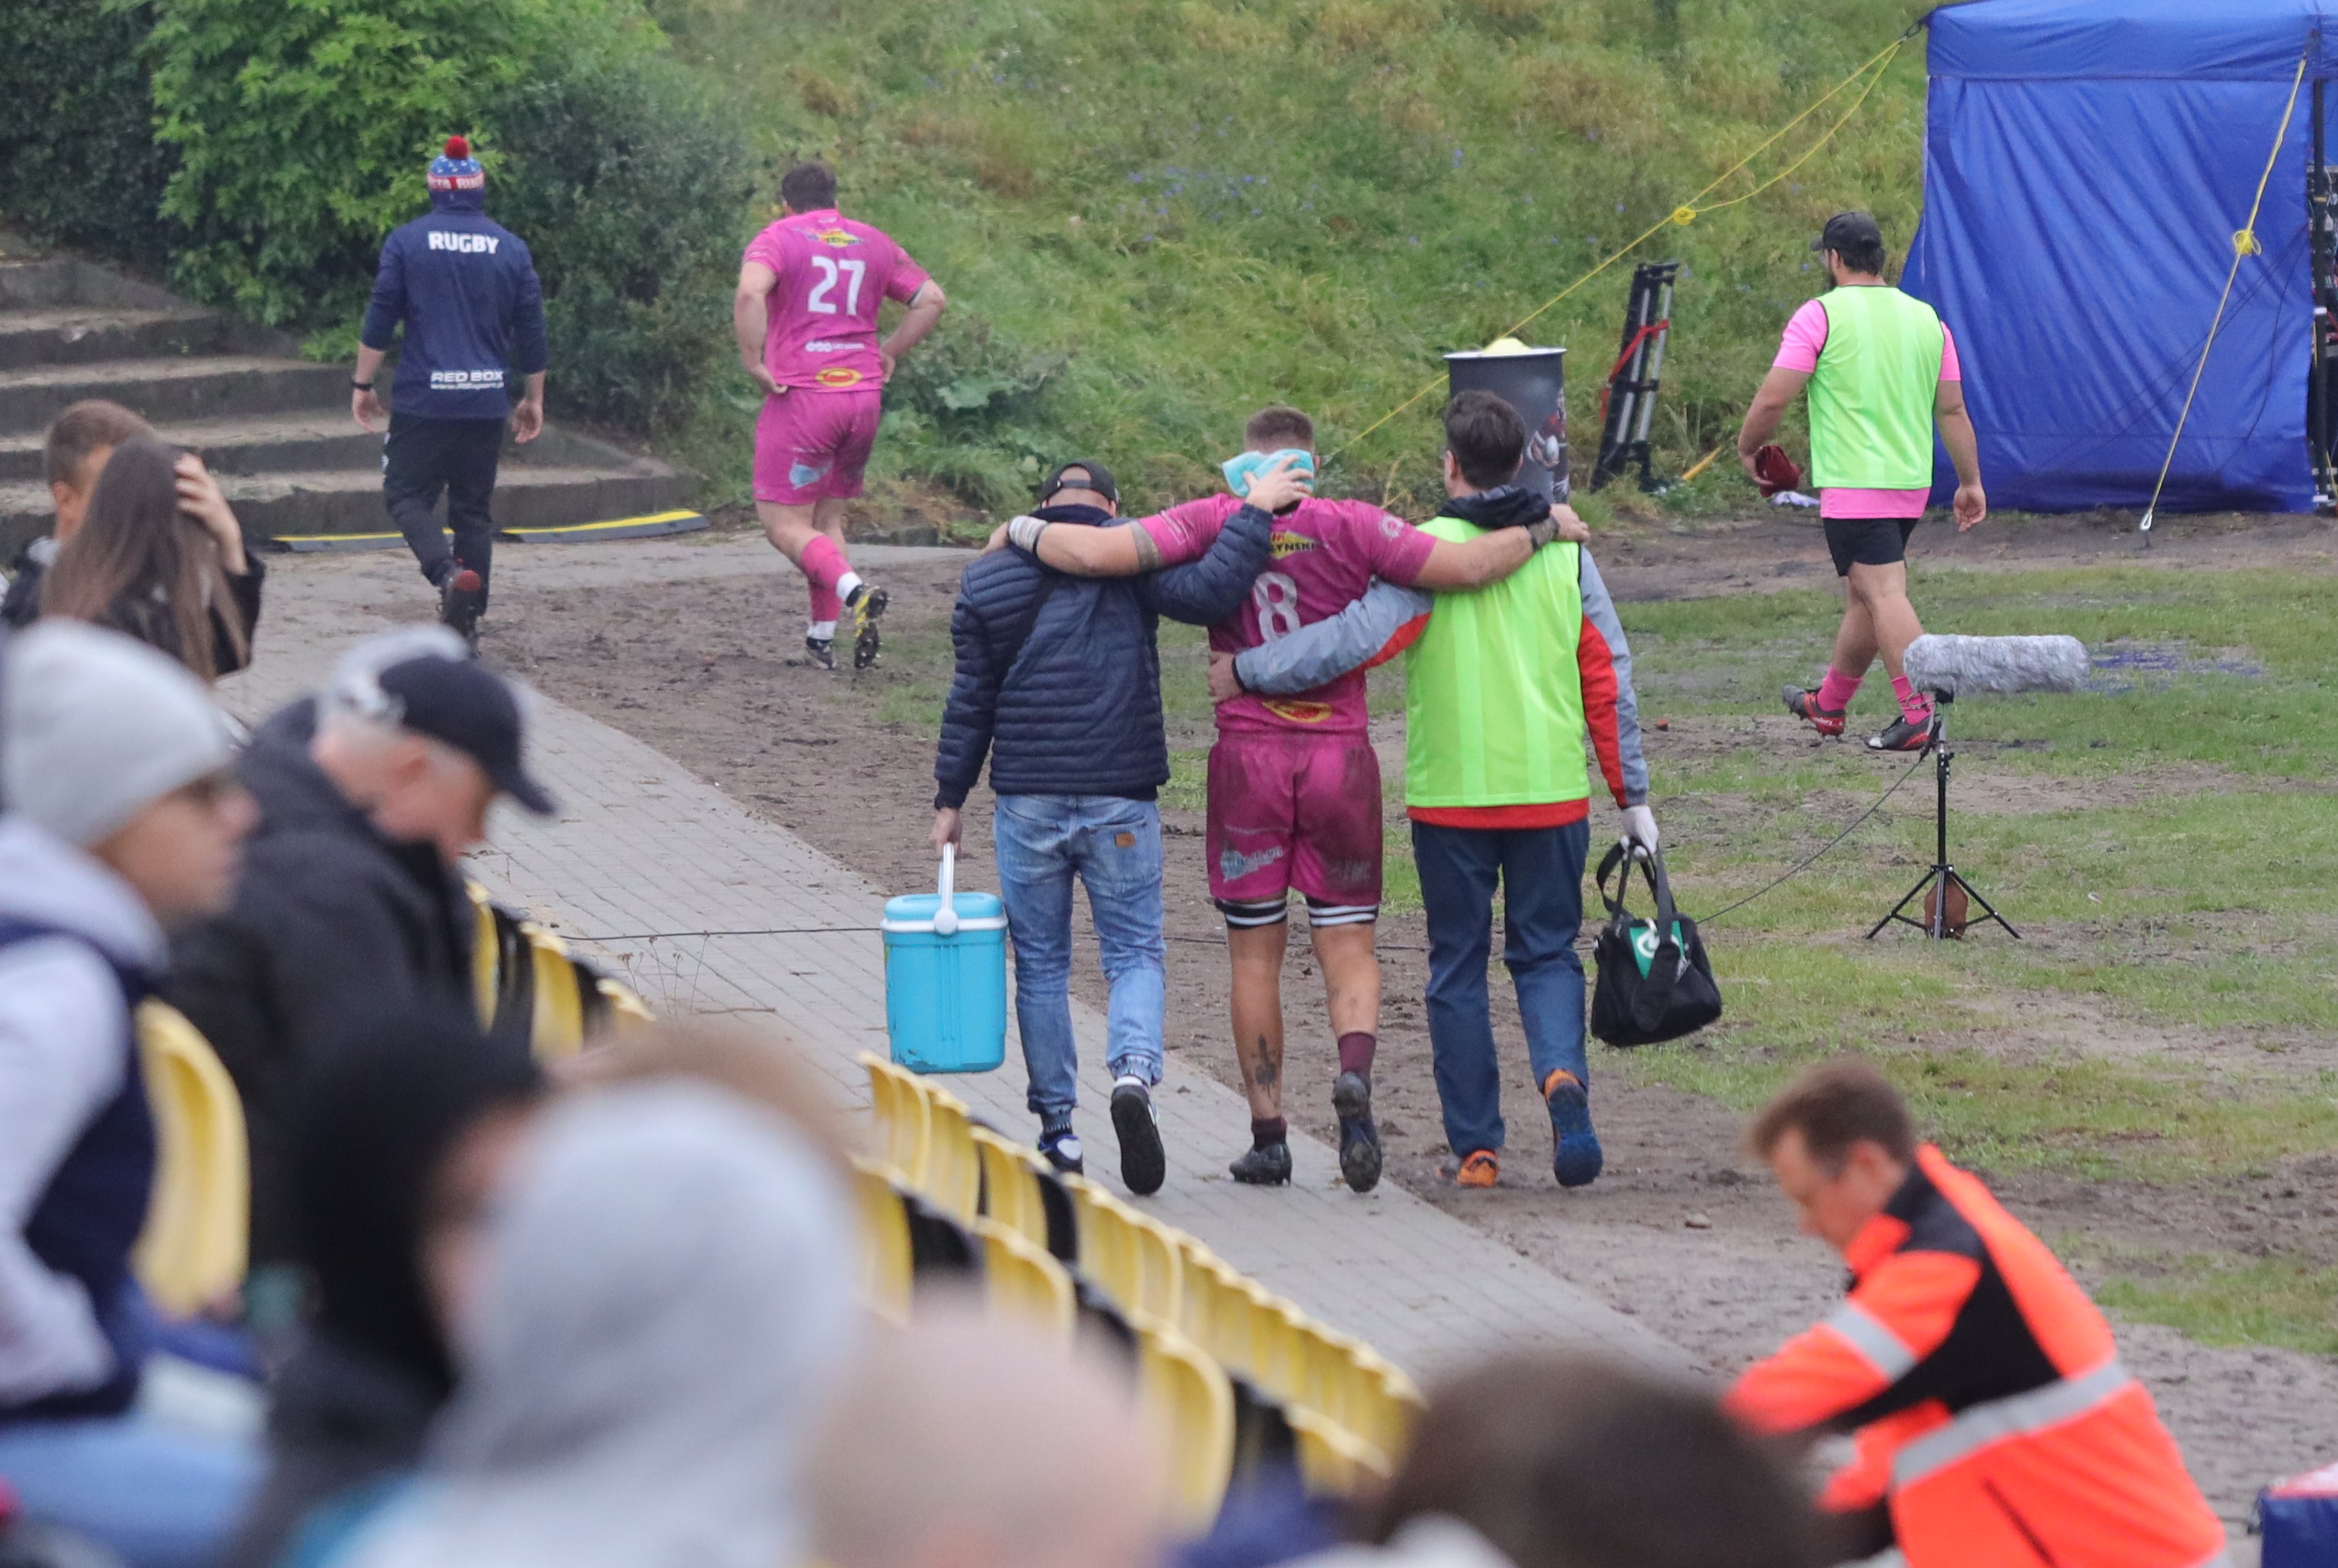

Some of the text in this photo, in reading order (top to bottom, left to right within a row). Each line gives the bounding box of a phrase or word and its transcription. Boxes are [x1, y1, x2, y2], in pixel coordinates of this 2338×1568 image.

[428, 231, 500, 254] RUGBY
[807, 256, 866, 316] 27
[431, 369, 504, 383] RED BOX
[1252, 571, 1300, 641] 8
